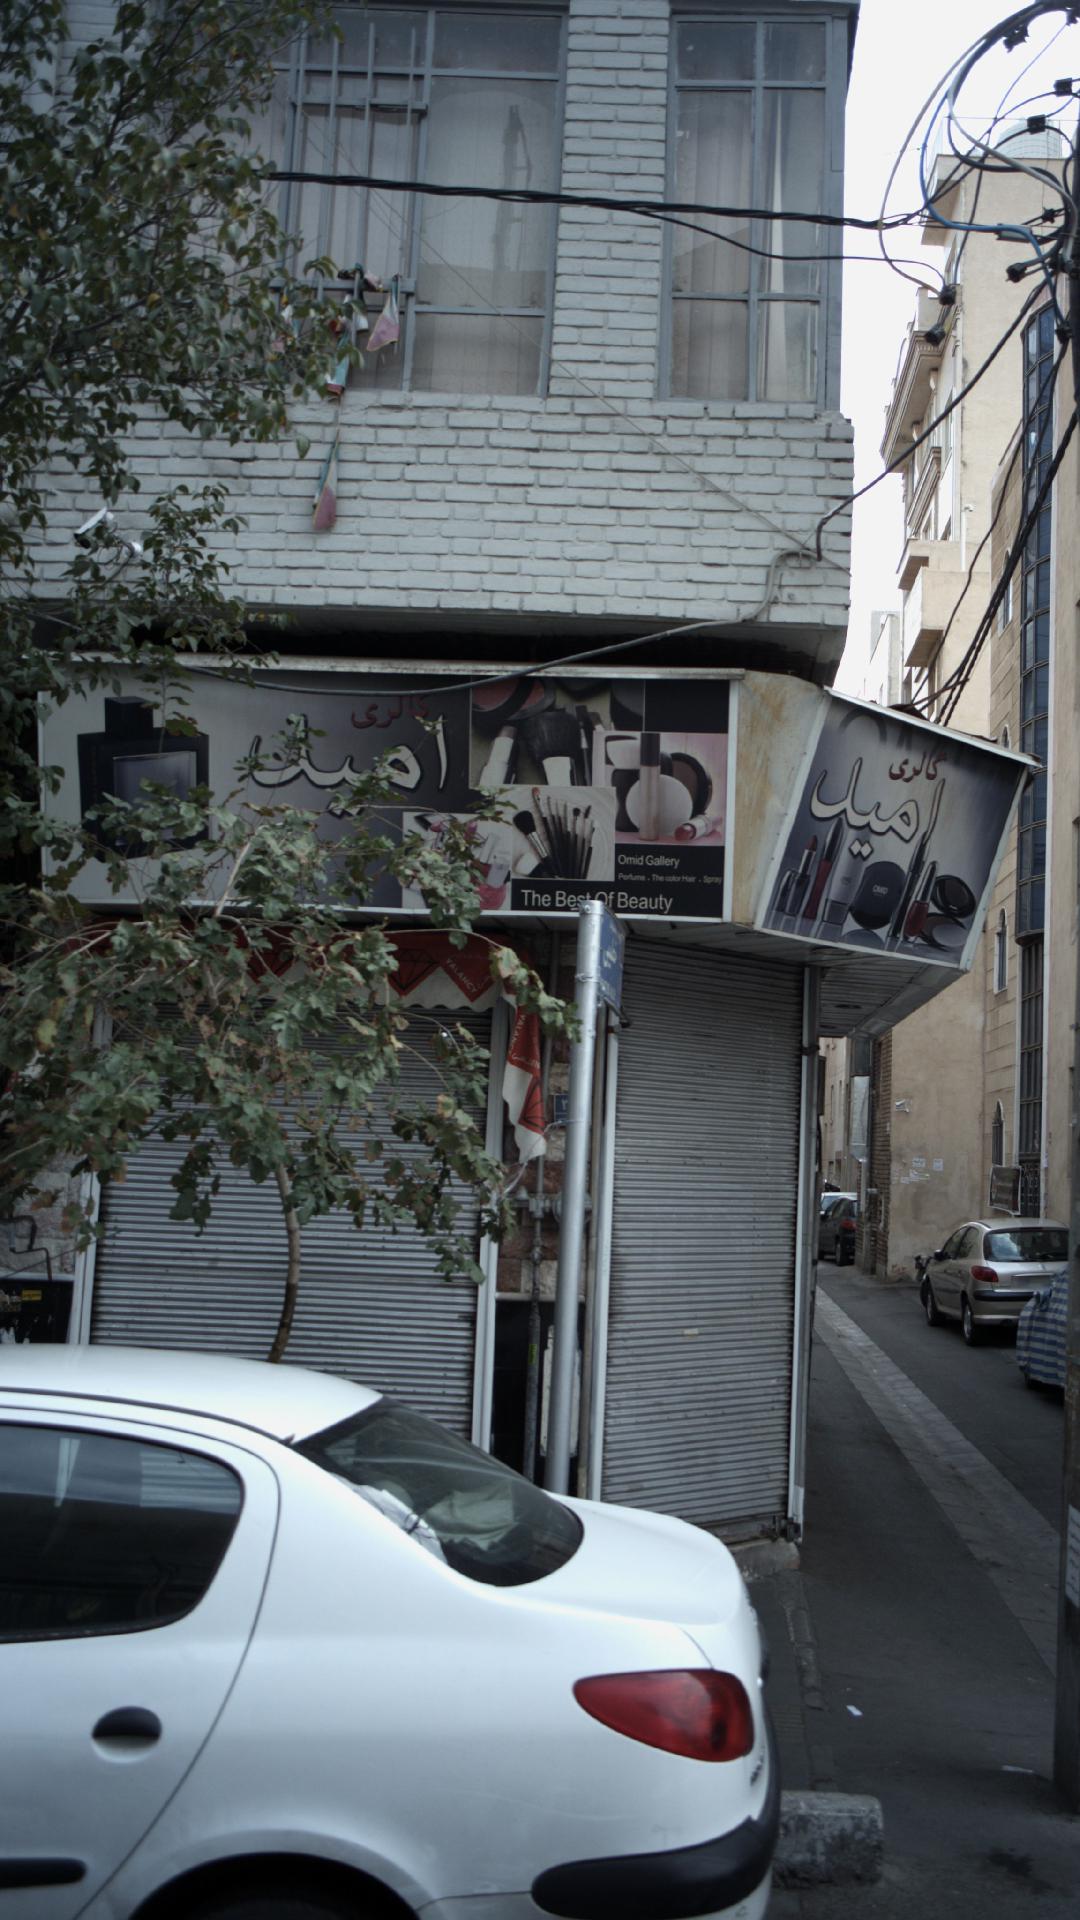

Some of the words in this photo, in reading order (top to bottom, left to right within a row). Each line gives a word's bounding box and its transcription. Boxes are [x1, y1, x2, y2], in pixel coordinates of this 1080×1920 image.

[810, 756, 945, 861] امید
[617, 854, 644, 866] Omid
[645, 854, 680, 869] Gallery
[703, 875, 722, 884] Spray
[521, 889, 551, 908] The
[555, 890, 592, 909] Best
[594, 891, 615, 909] Of
[617, 892, 673, 914] Beauty
